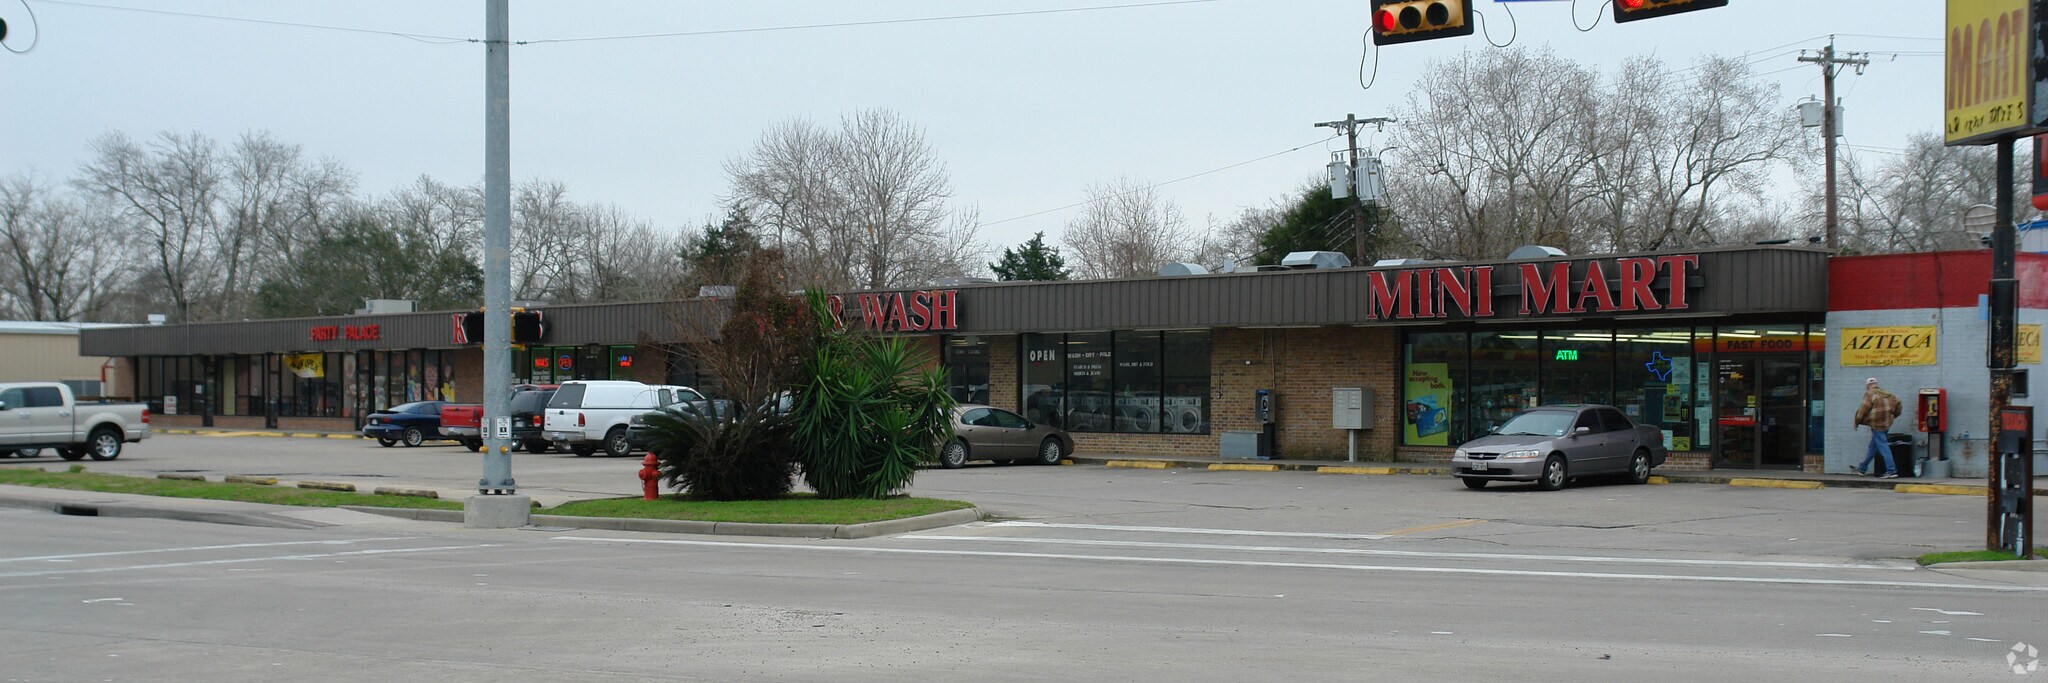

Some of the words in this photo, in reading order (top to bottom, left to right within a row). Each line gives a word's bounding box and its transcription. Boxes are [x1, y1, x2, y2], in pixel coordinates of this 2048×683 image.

[1948, 8, 2024, 111] MART
[1367, 265, 1494, 319] MINI
[1518, 254, 1699, 315] MART
[857, 290, 957, 332] WASH
[311, 325, 338, 341] PARTY
[345, 323, 380, 340] PALACE
[2017, 332, 2040, 347] ECA
[1727, 340, 1755, 349] FAST
[1761, 340, 1793, 349] FOOD
[1844, 333, 1932, 350] AZTECA
[558, 358, 573, 368] OPEN
[1030, 350, 1055, 361] OPEN
[1556, 350, 1578, 360] ATM
